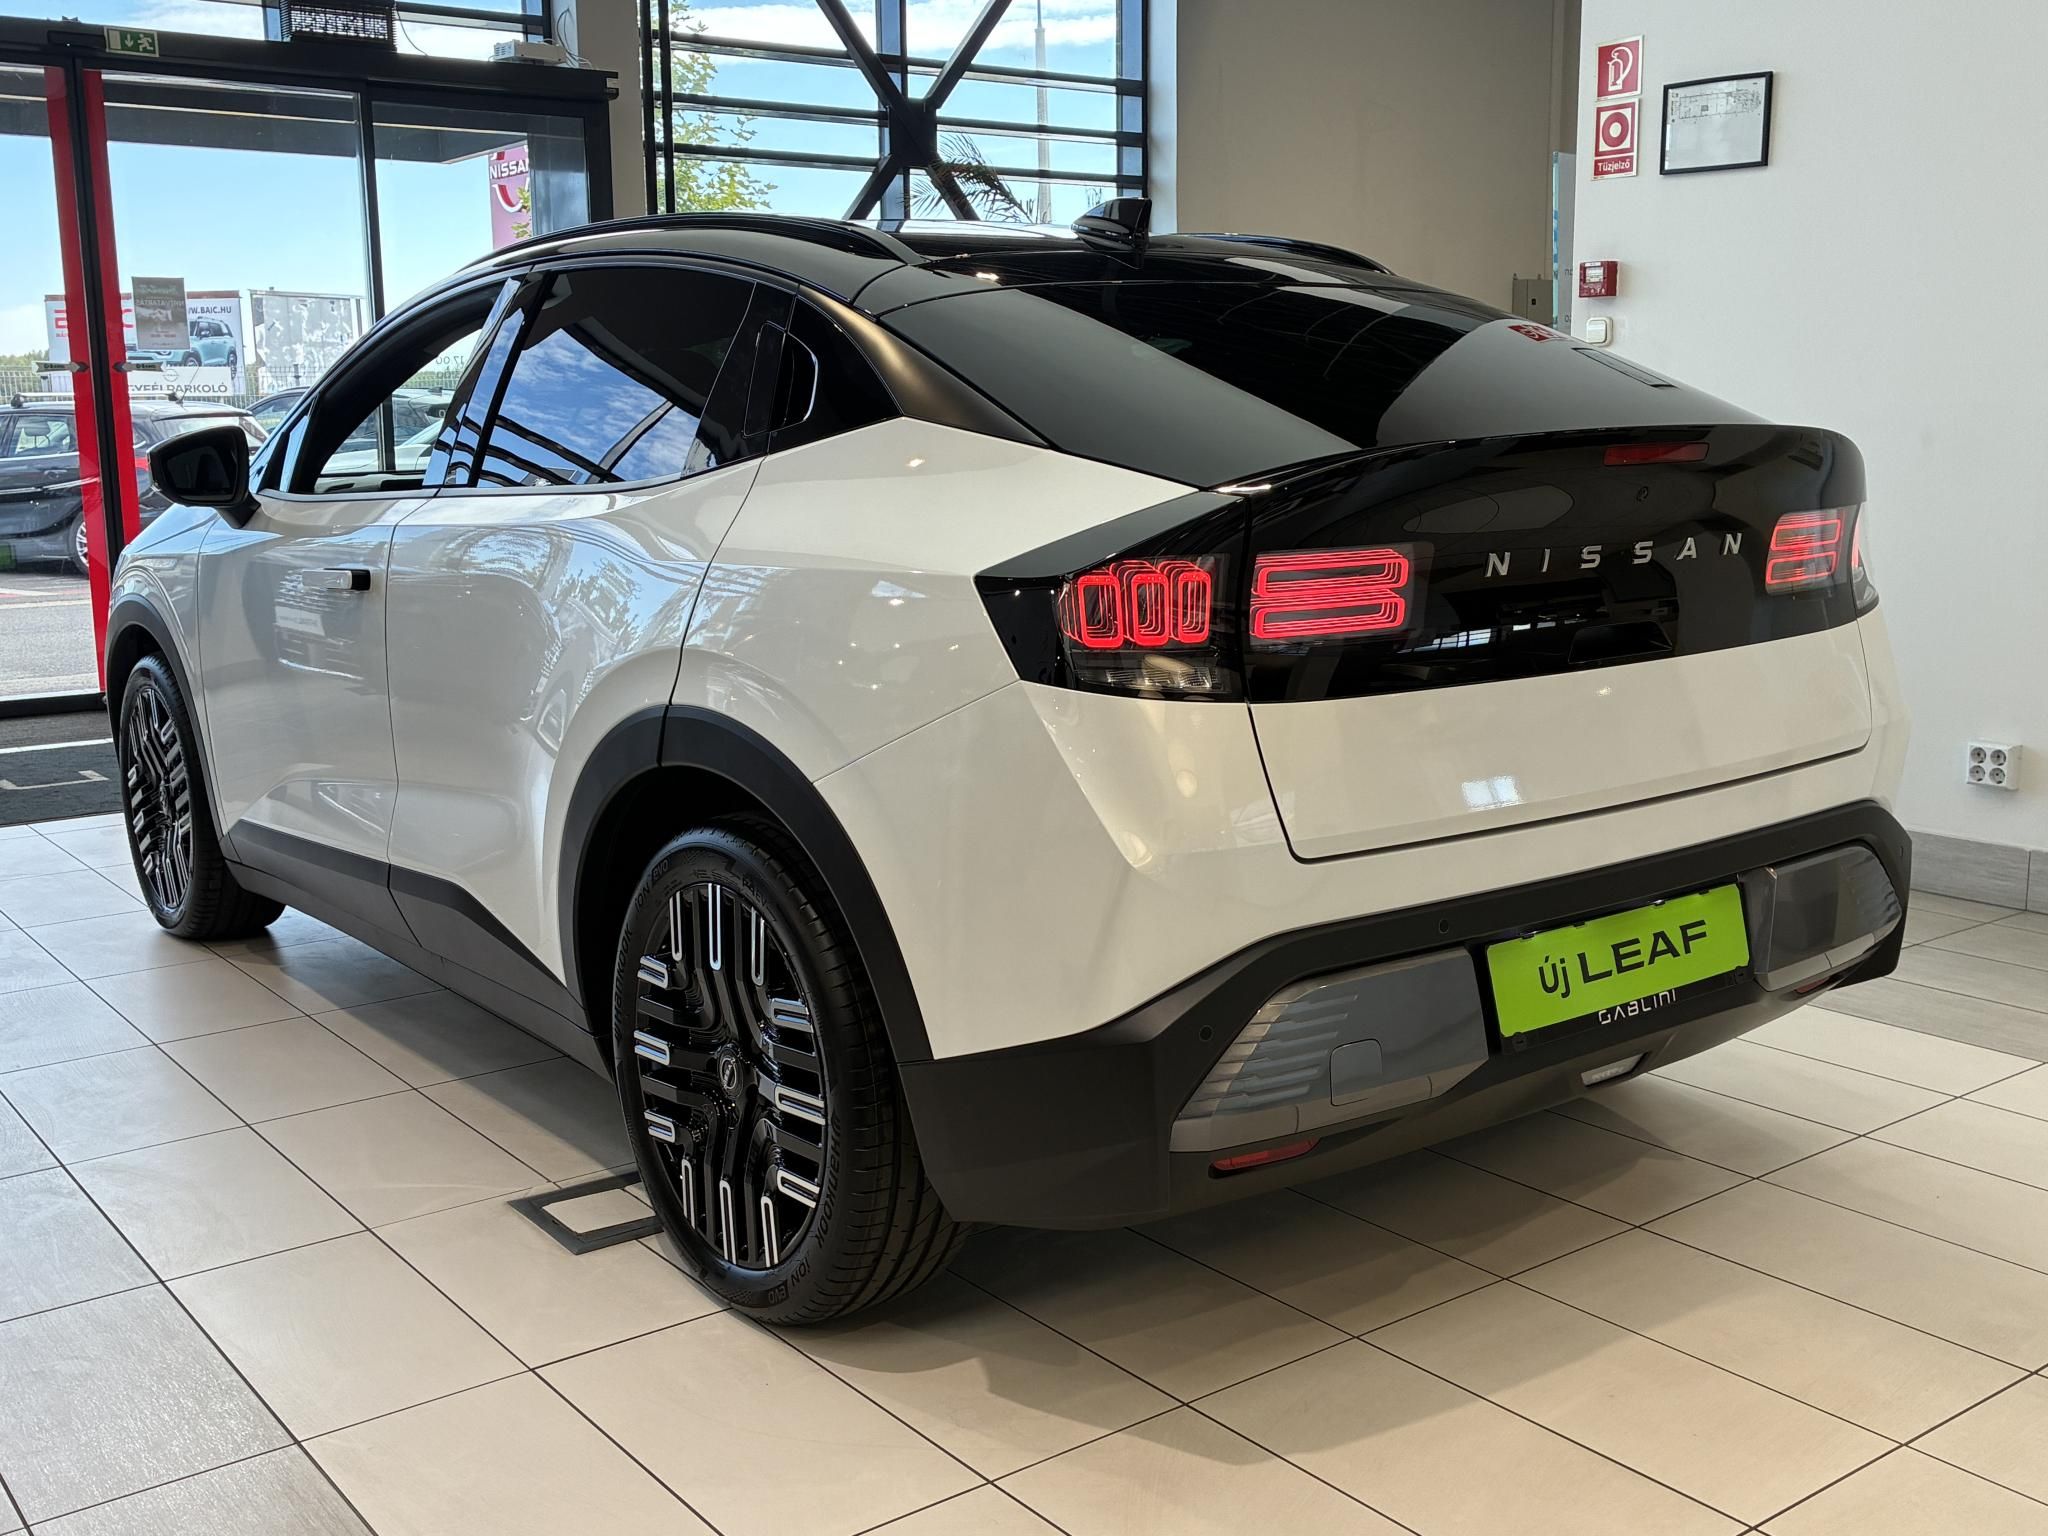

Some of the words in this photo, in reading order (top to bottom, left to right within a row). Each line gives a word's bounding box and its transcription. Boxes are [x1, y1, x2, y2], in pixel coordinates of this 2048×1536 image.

[1485, 532, 1742, 577] NISSAN
[1538, 955, 1571, 999] Új
[1577, 919, 1707, 984] LEAF
[1598, 988, 1677, 1025] GABLINI
